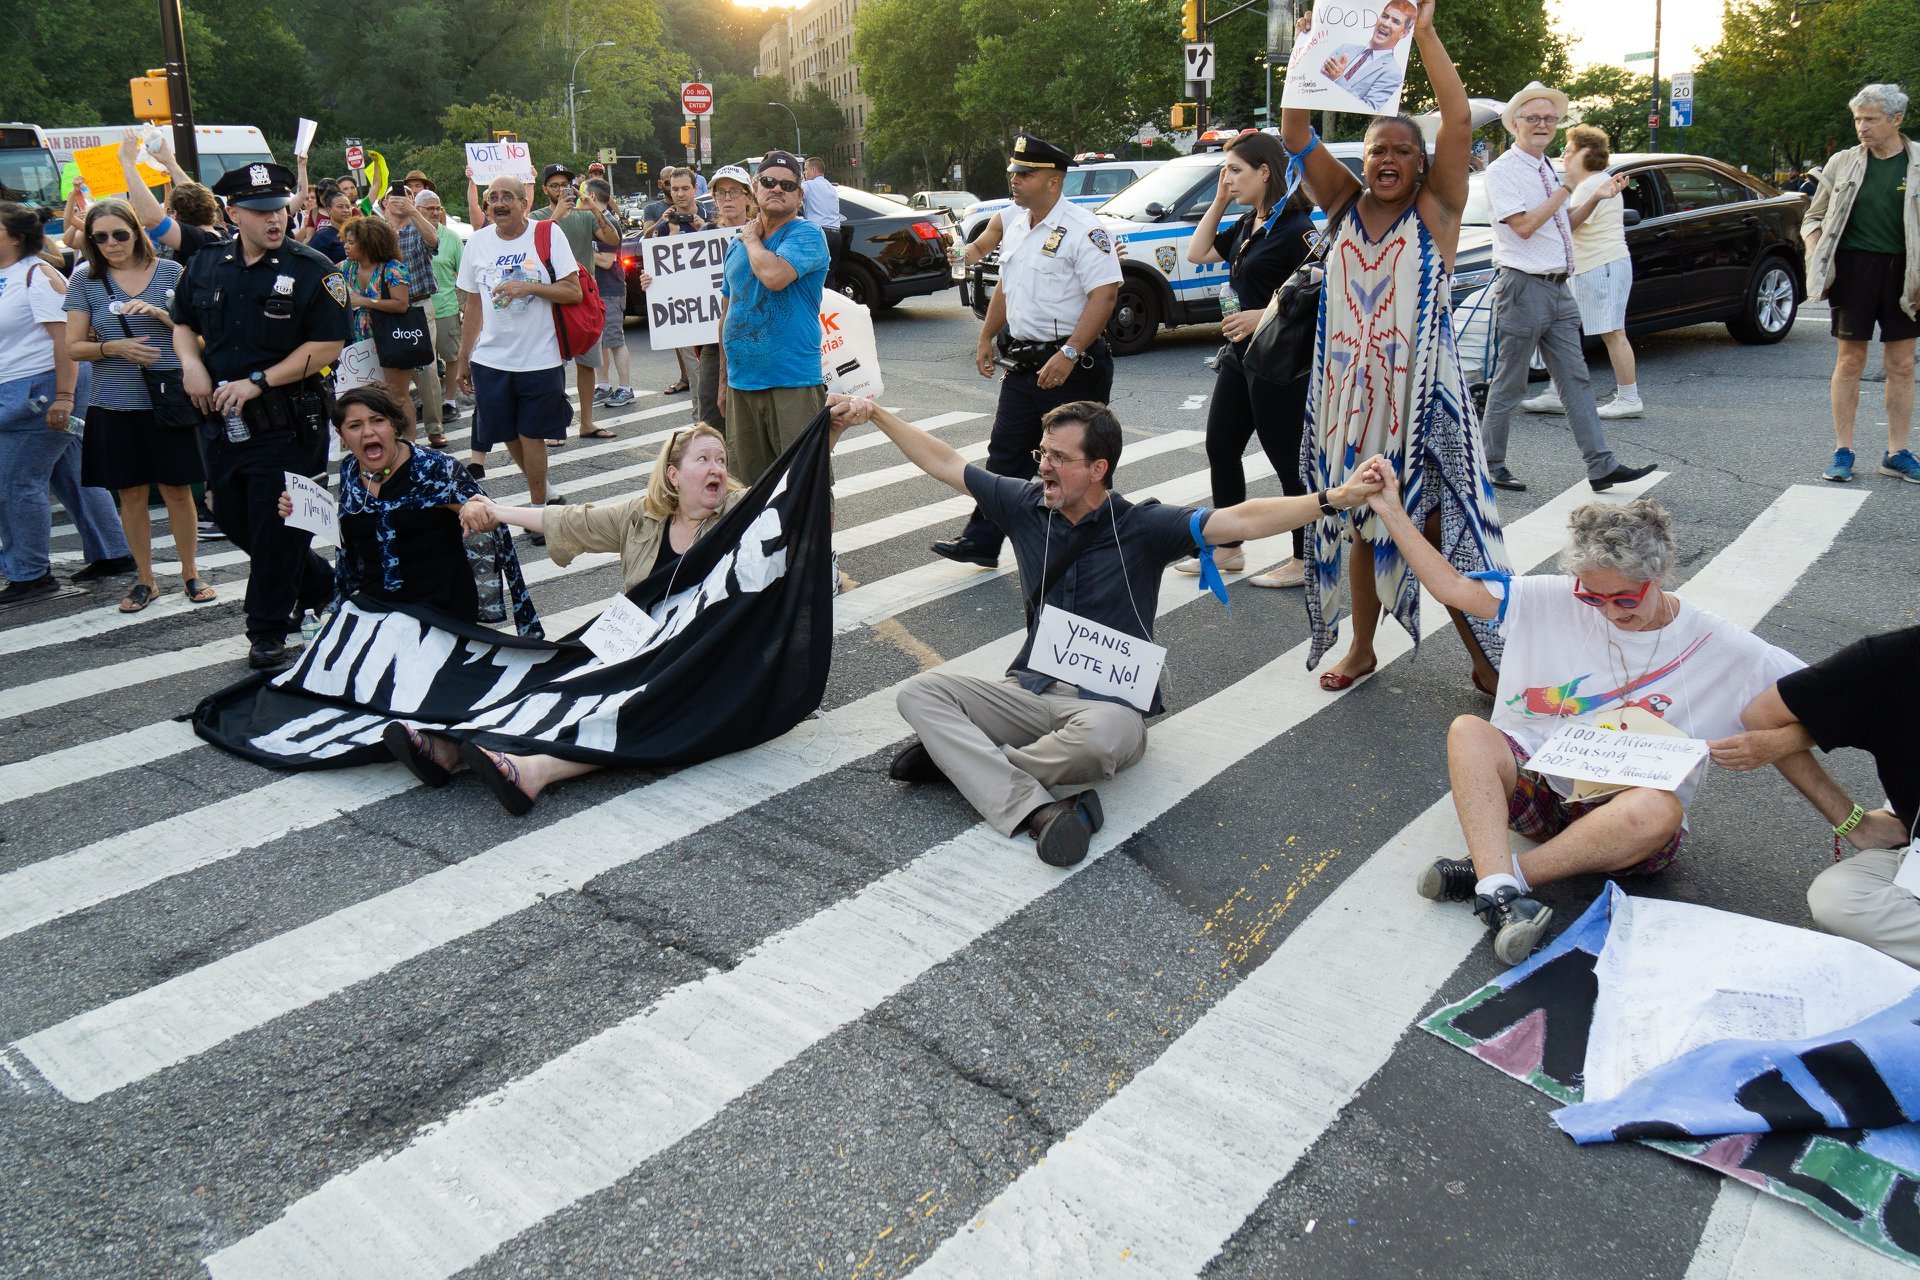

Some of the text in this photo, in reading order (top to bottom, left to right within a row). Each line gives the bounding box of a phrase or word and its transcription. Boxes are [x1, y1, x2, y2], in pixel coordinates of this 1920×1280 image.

[1674, 87, 1690, 98] 20
[63, 136, 101, 149] BREAD
[470, 144, 526, 162] VOTE NO
[1066, 620, 1131, 657] YDANIS,
[1053, 643, 1103, 674] VOTE
[1563, 726, 1695, 755] 100% Affordable
[1538, 751, 1573, 769] 50%
[1556, 740, 1628, 764] Housing
